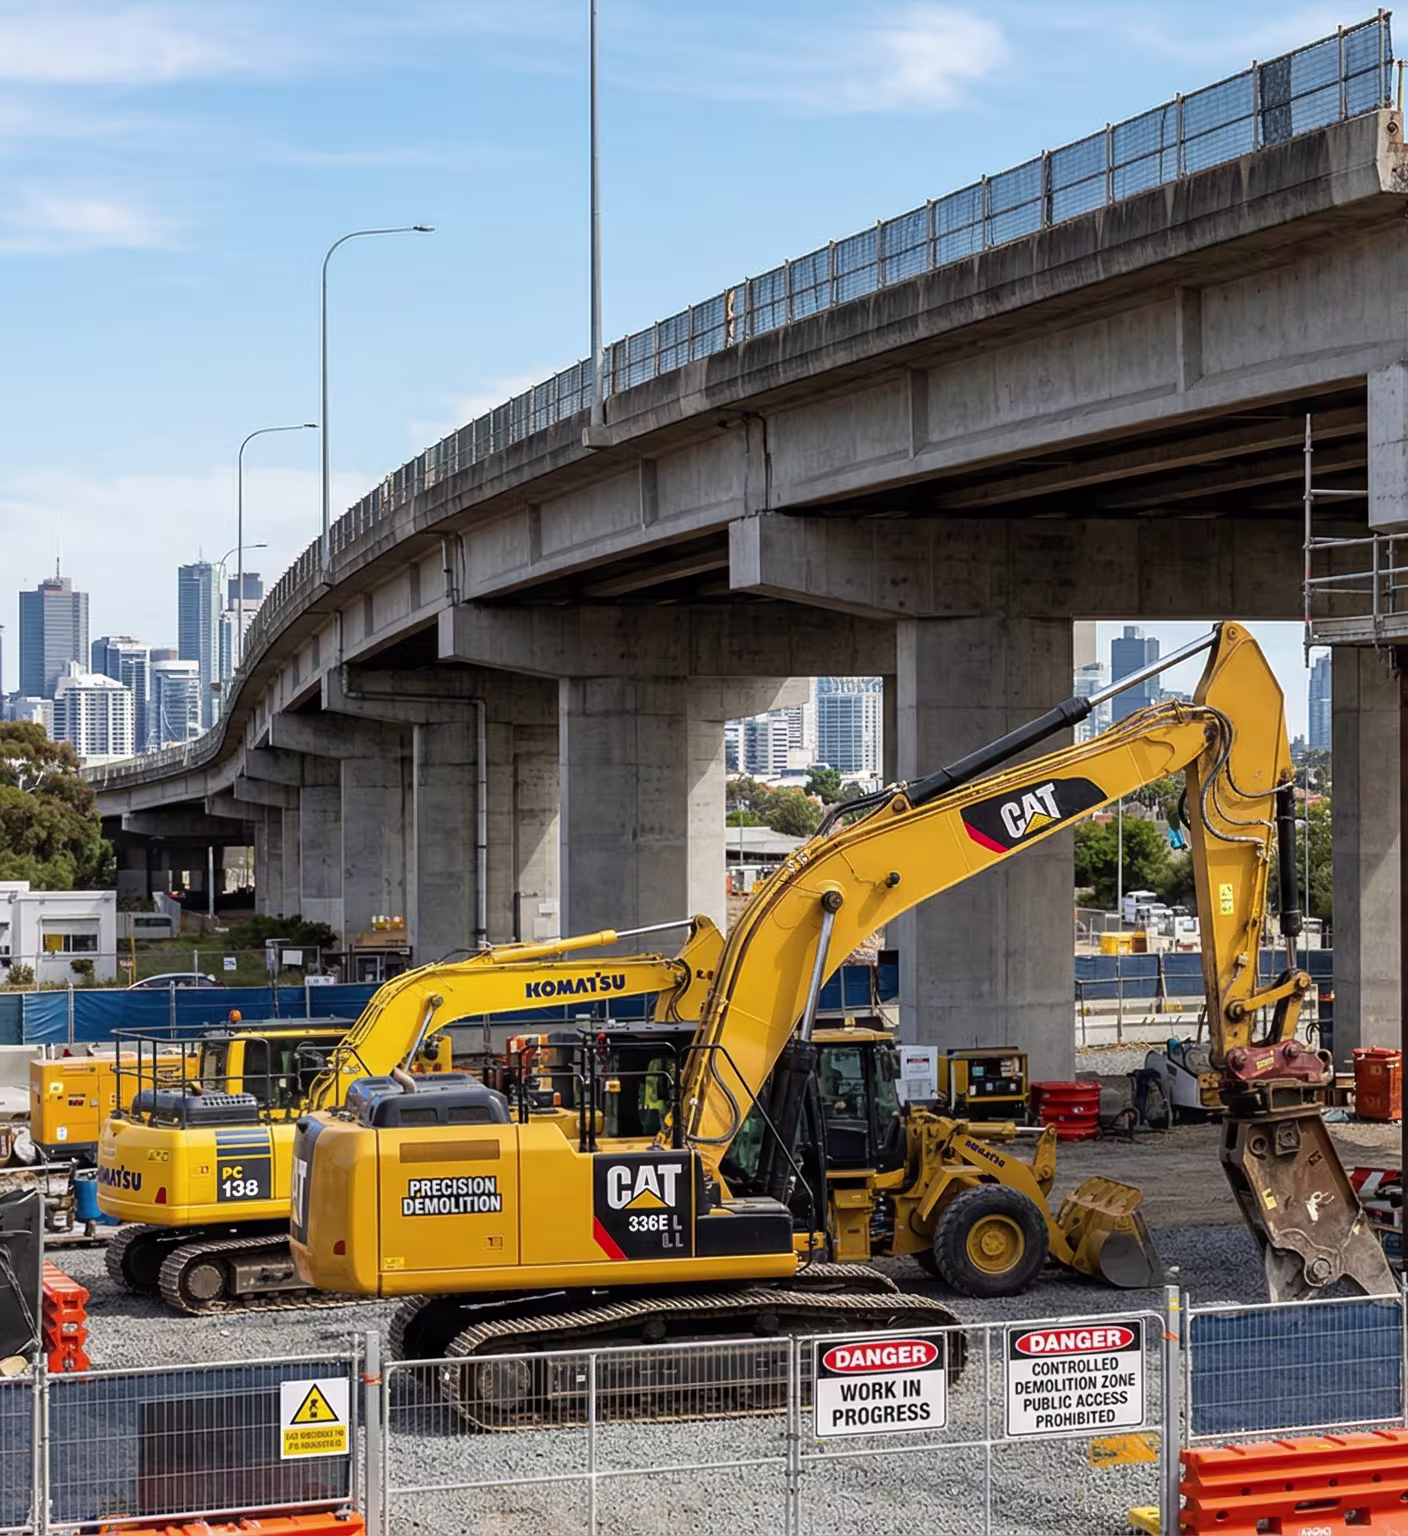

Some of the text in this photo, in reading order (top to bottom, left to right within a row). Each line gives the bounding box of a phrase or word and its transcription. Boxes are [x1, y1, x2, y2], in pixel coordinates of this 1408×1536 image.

[1001, 783, 1061, 838] CAT
[526, 972, 625, 998] KOMATSU
[222, 1166, 242, 1179] PC
[222, 1180, 258, 1197] 138
[292, 1155, 307, 1228] AT
[410, 1177, 496, 1197] PRECISION
[607, 1164, 682, 1209] CAT
[403, 1196, 501, 1215] DEMOLITION
[629, 1215, 668, 1231] 336E
[1029, 1330, 1122, 1352] DANGER
[836, 1345, 927, 1368] DANGER
[1032, 1357, 1119, 1376] CONTROLLED
[840, 1379, 921, 1402] WORK IN
[1015, 1373, 1135, 1395] DEMOLITION ZONE
[1024, 1391, 1128, 1412] PUBLIC ACCESS
[832, 1402, 930, 1427] PROGRESS
[1036, 1409, 1115, 1428] PROHIBITED
